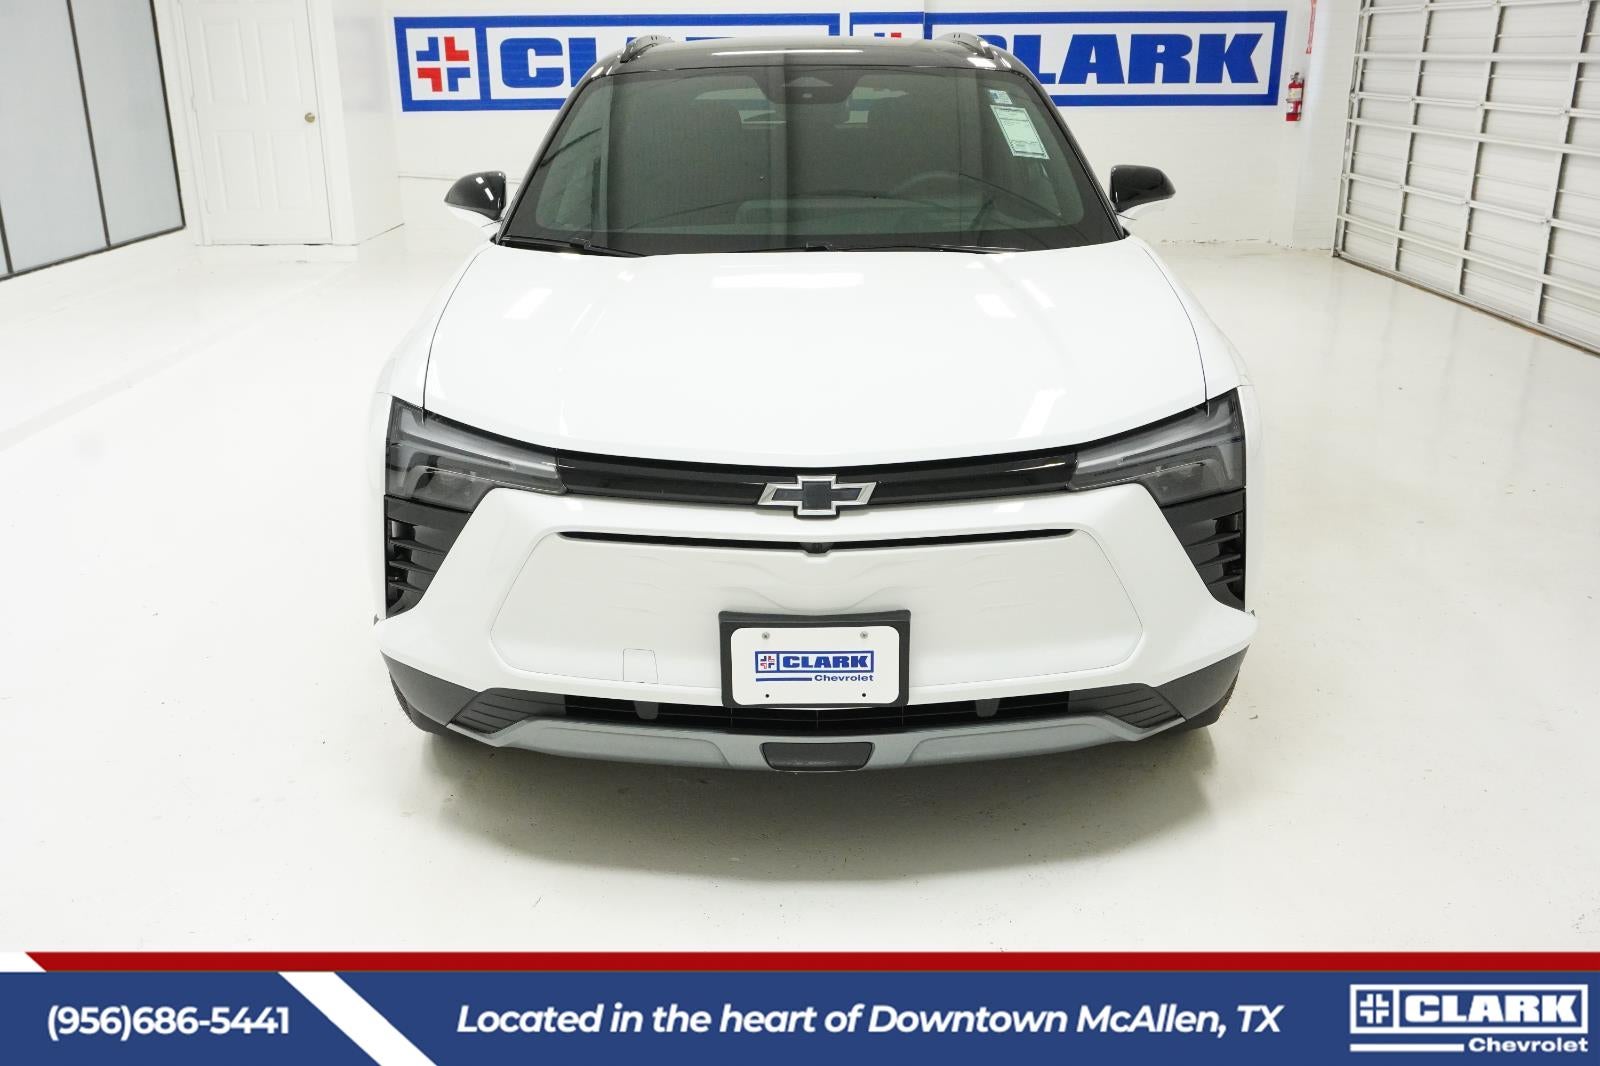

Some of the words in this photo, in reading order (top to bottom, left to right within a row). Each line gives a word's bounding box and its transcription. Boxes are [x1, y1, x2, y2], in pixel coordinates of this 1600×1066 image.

[977, 33, 1263, 85] LARK
[782, 655, 869, 669] CLARK
[814, 674, 874, 682] Chevrolet
